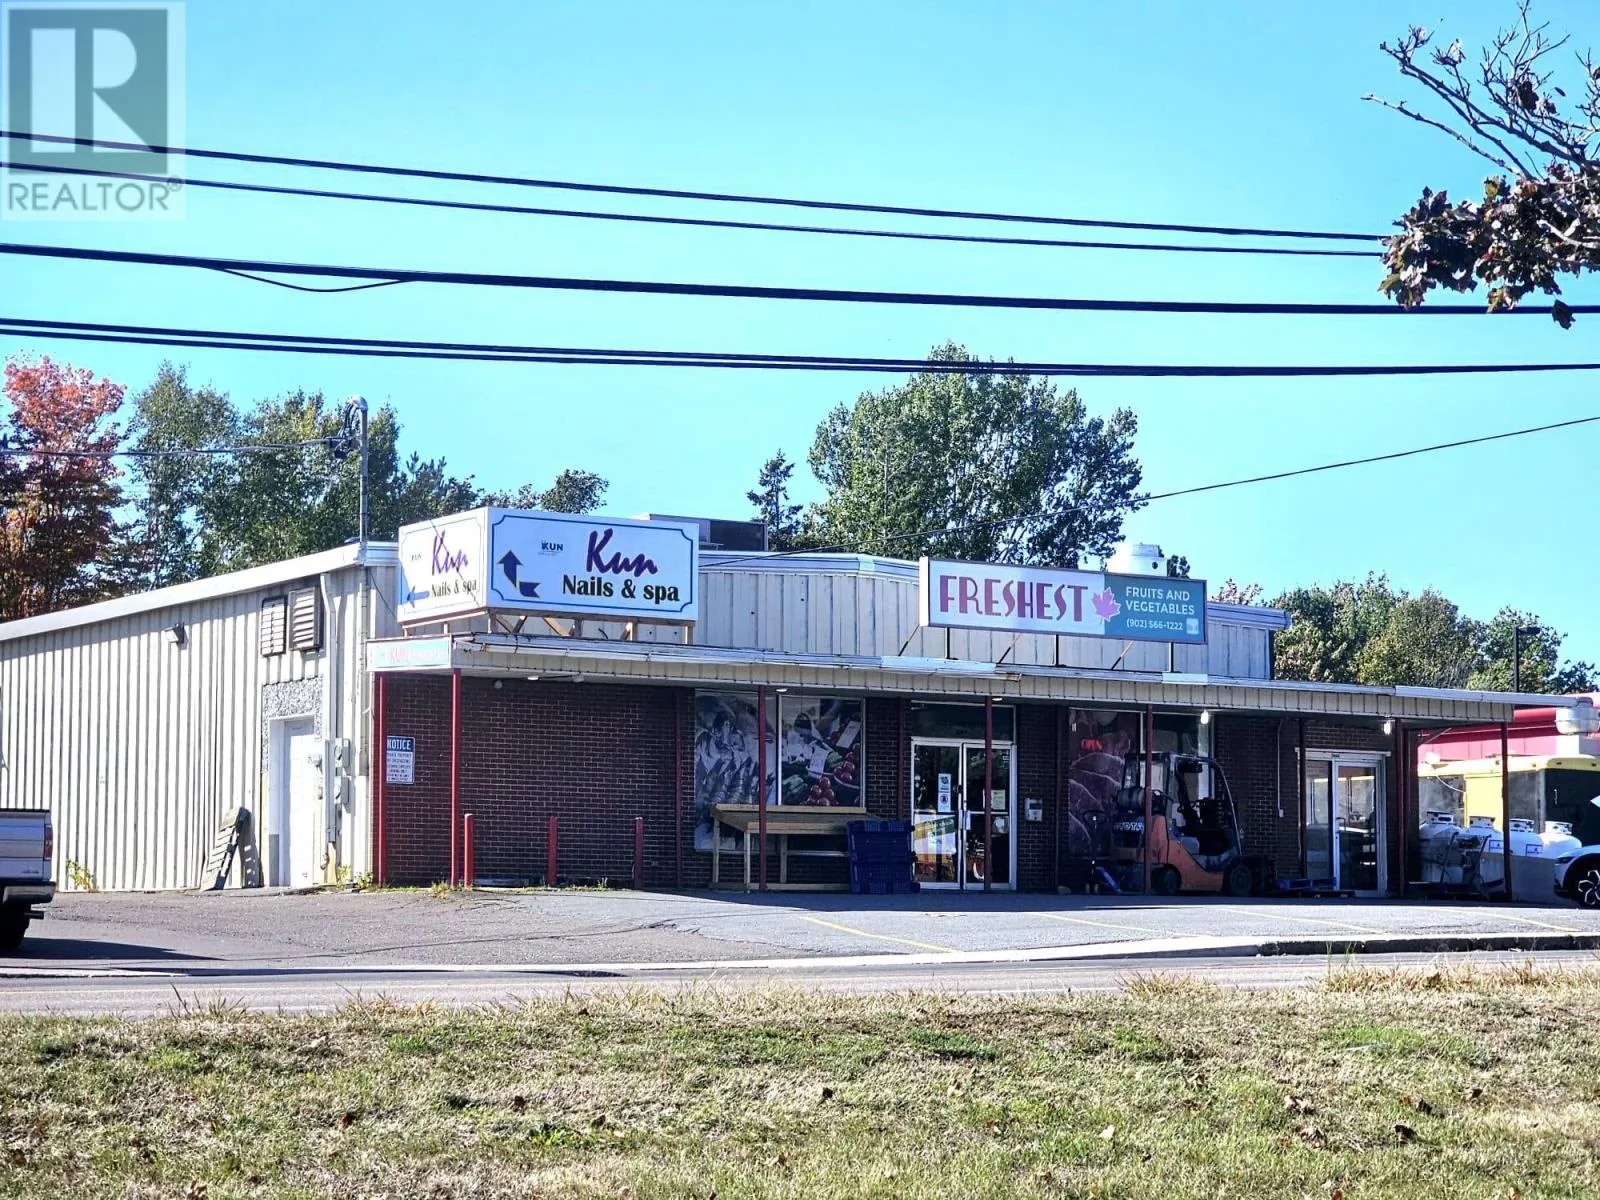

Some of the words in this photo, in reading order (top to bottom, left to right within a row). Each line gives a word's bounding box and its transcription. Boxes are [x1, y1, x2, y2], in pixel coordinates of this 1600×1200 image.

[432, 529, 468, 576] Kun
[541, 541, 564, 551] KUN
[586, 528, 658, 577] Kun
[431, 581, 451, 598] Nails
[462, 579, 477, 595] spa
[563, 574, 614, 597] Nails
[621, 579, 636, 599] &
[643, 584, 680, 605] spa
[1126, 586, 1164, 599] FRUITS
[1166, 589, 1190, 601] AND
[939, 575, 1089, 622] FRESHEST
[1126, 600, 1195, 615] VEGETABLES
[1126, 618, 1148, 629] (902)
[1149, 620, 1184, 630] 566-1222
[387, 739, 411, 750] NOTICE
